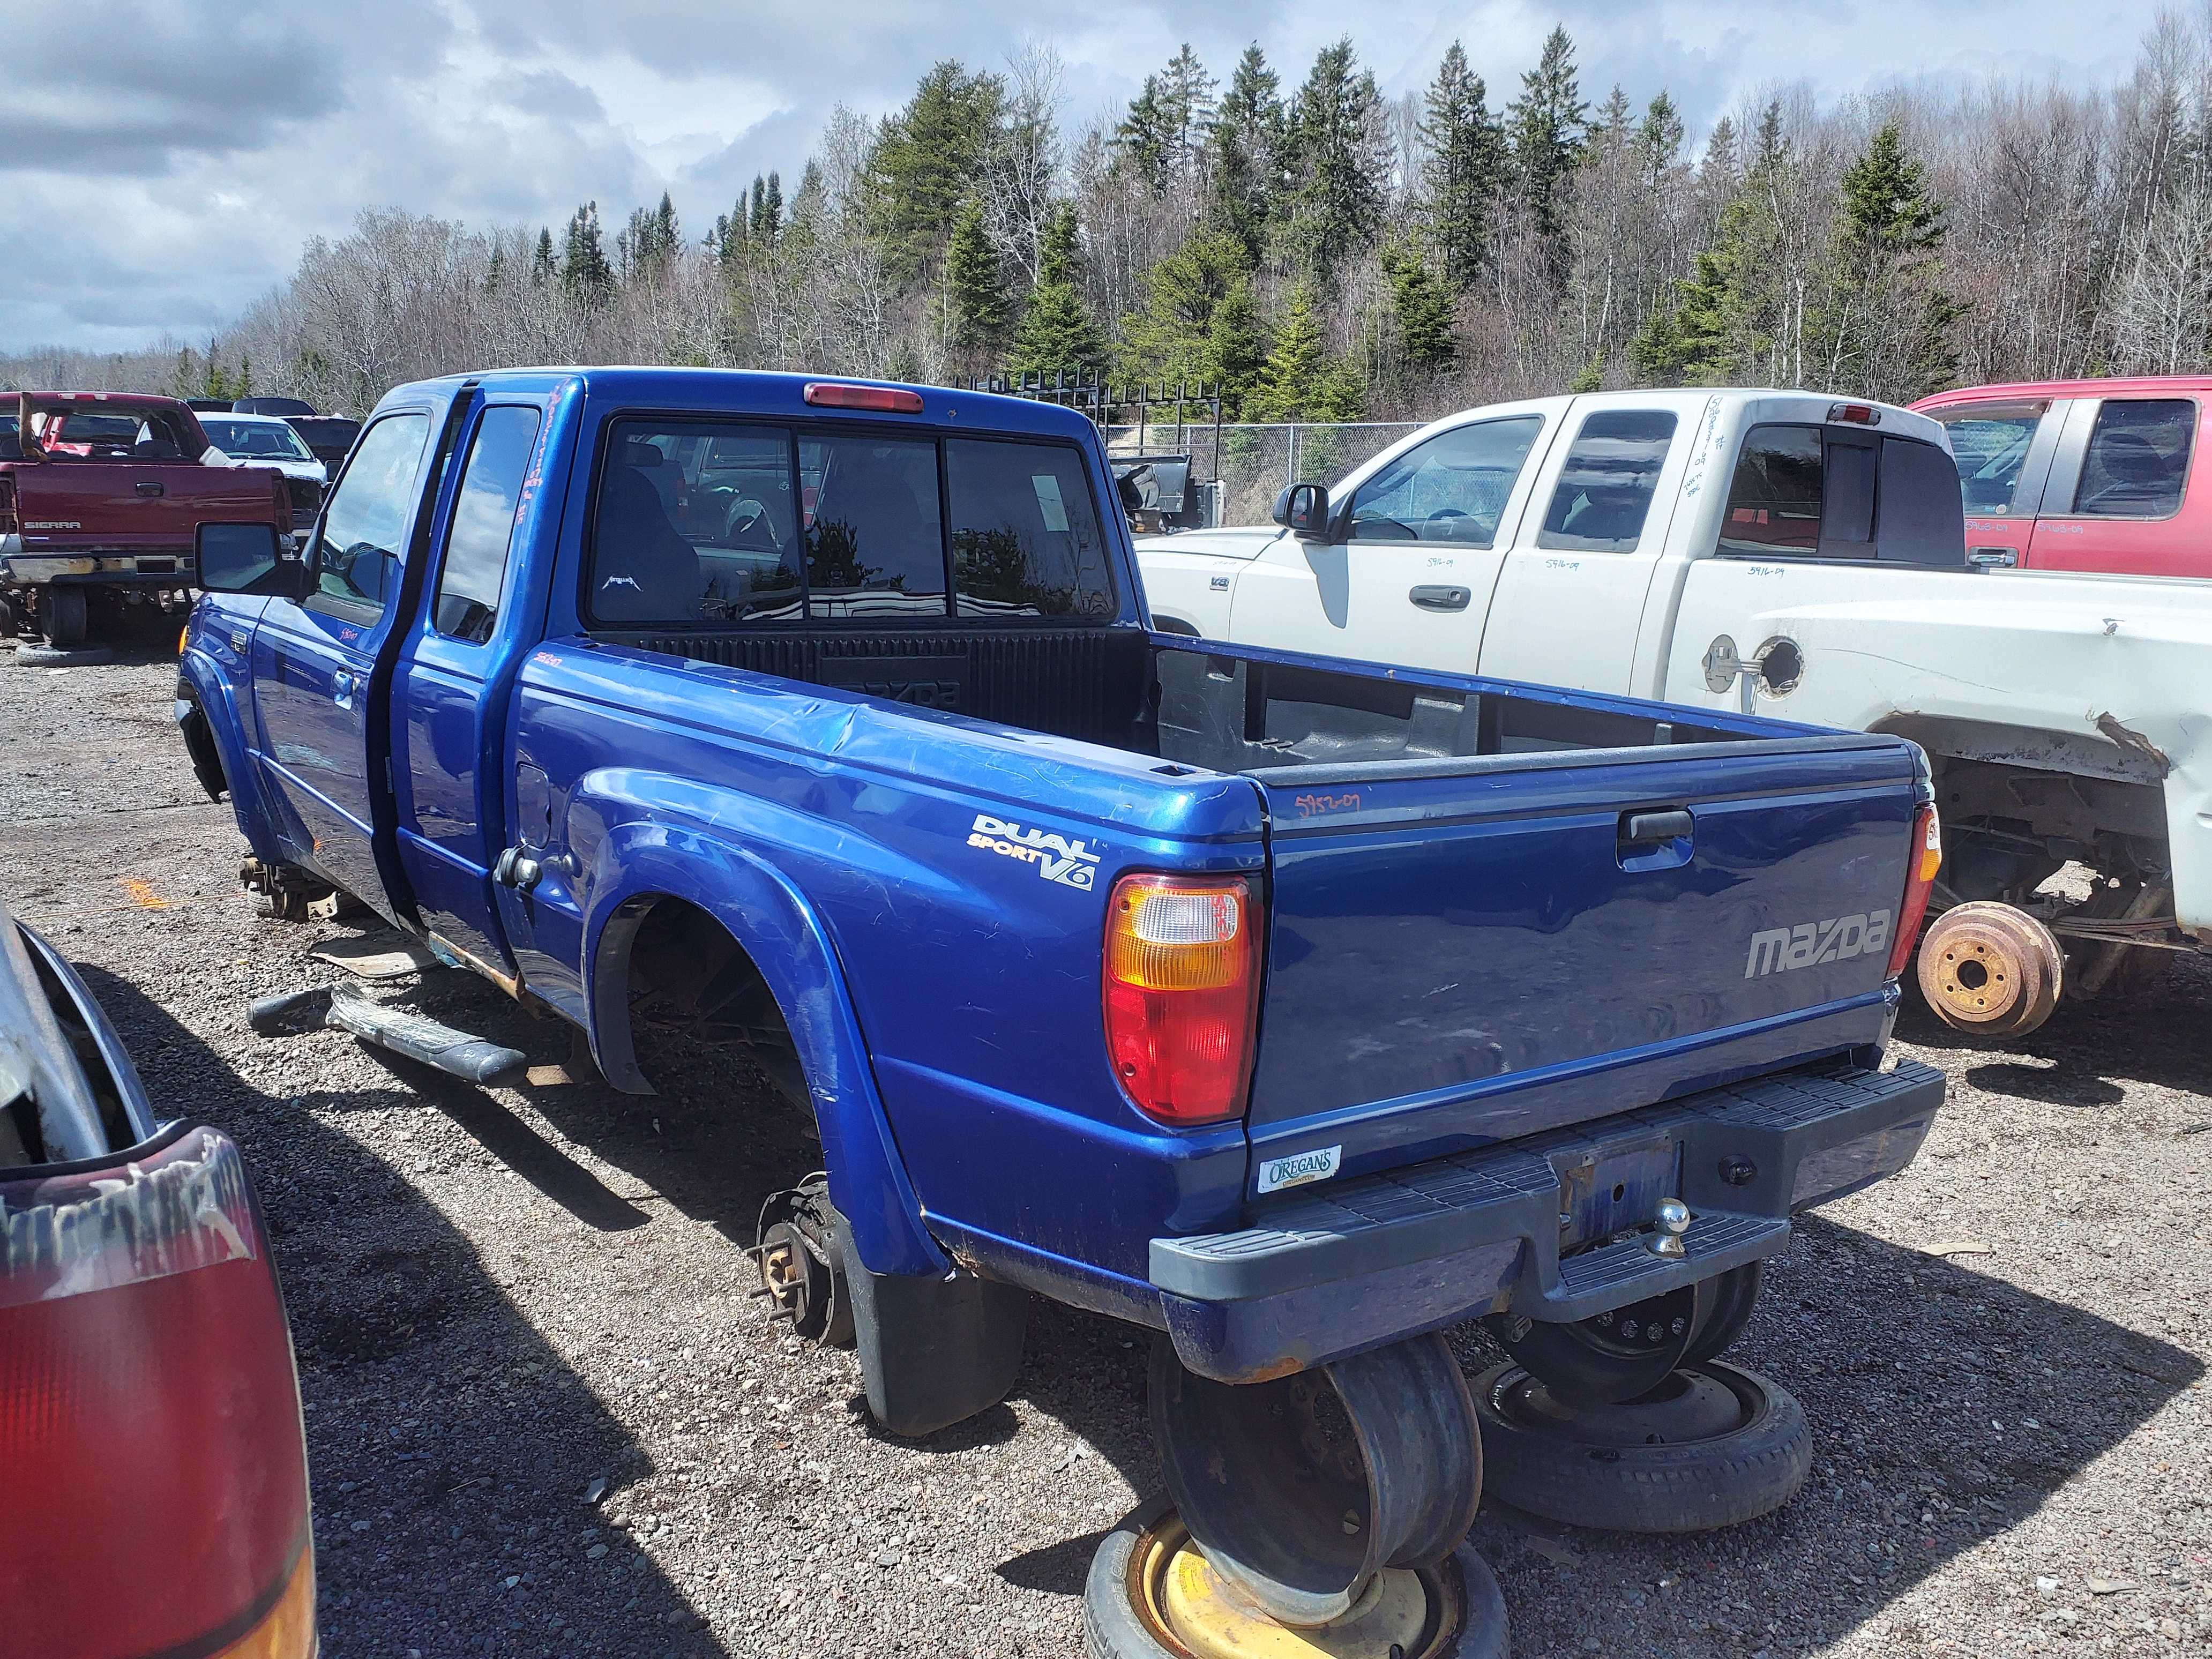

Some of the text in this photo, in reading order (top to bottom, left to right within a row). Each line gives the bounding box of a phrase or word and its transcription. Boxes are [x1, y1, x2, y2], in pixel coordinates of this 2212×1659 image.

[24, 521, 81, 529] SIERRA
[1545, 559, 1580, 572] 5916-09
[1747, 566, 1785, 579] 5916-09
[1211, 576, 1230, 587] V8
[972, 813, 1101, 863] DUAL
[966, 833, 1096, 892] SPORT V6
